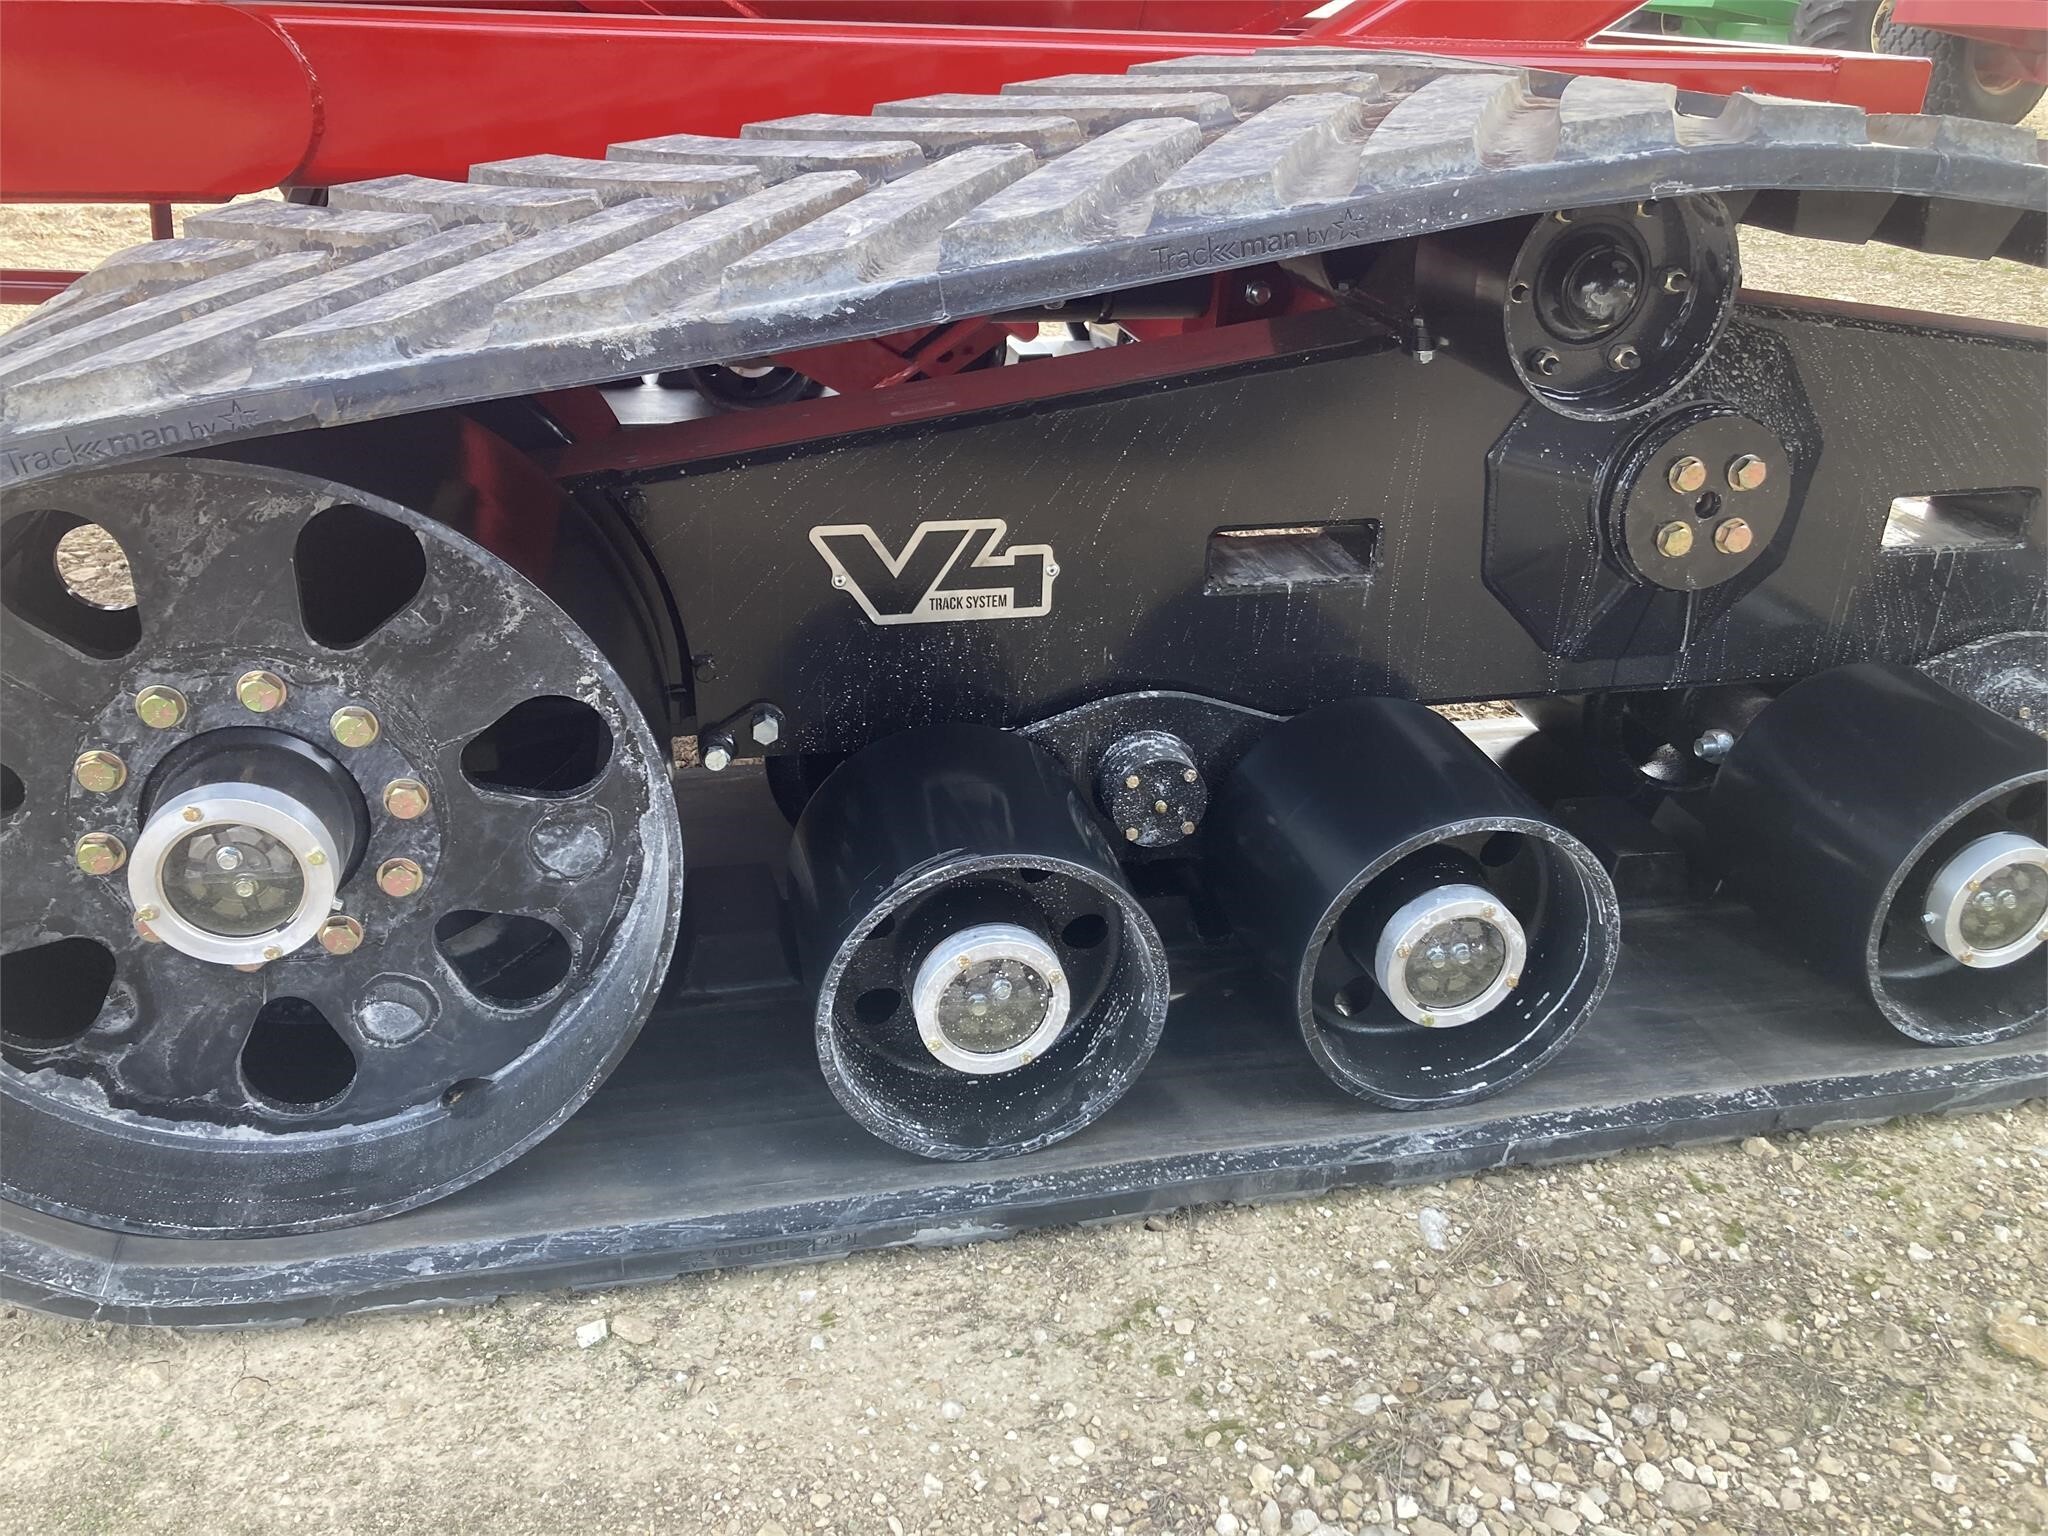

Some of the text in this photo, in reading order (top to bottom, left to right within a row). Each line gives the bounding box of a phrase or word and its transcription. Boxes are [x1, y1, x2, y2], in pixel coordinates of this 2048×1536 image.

[1306, 227, 1329, 246] by
[929, 593, 1008, 611] TRACK SYSTEM
